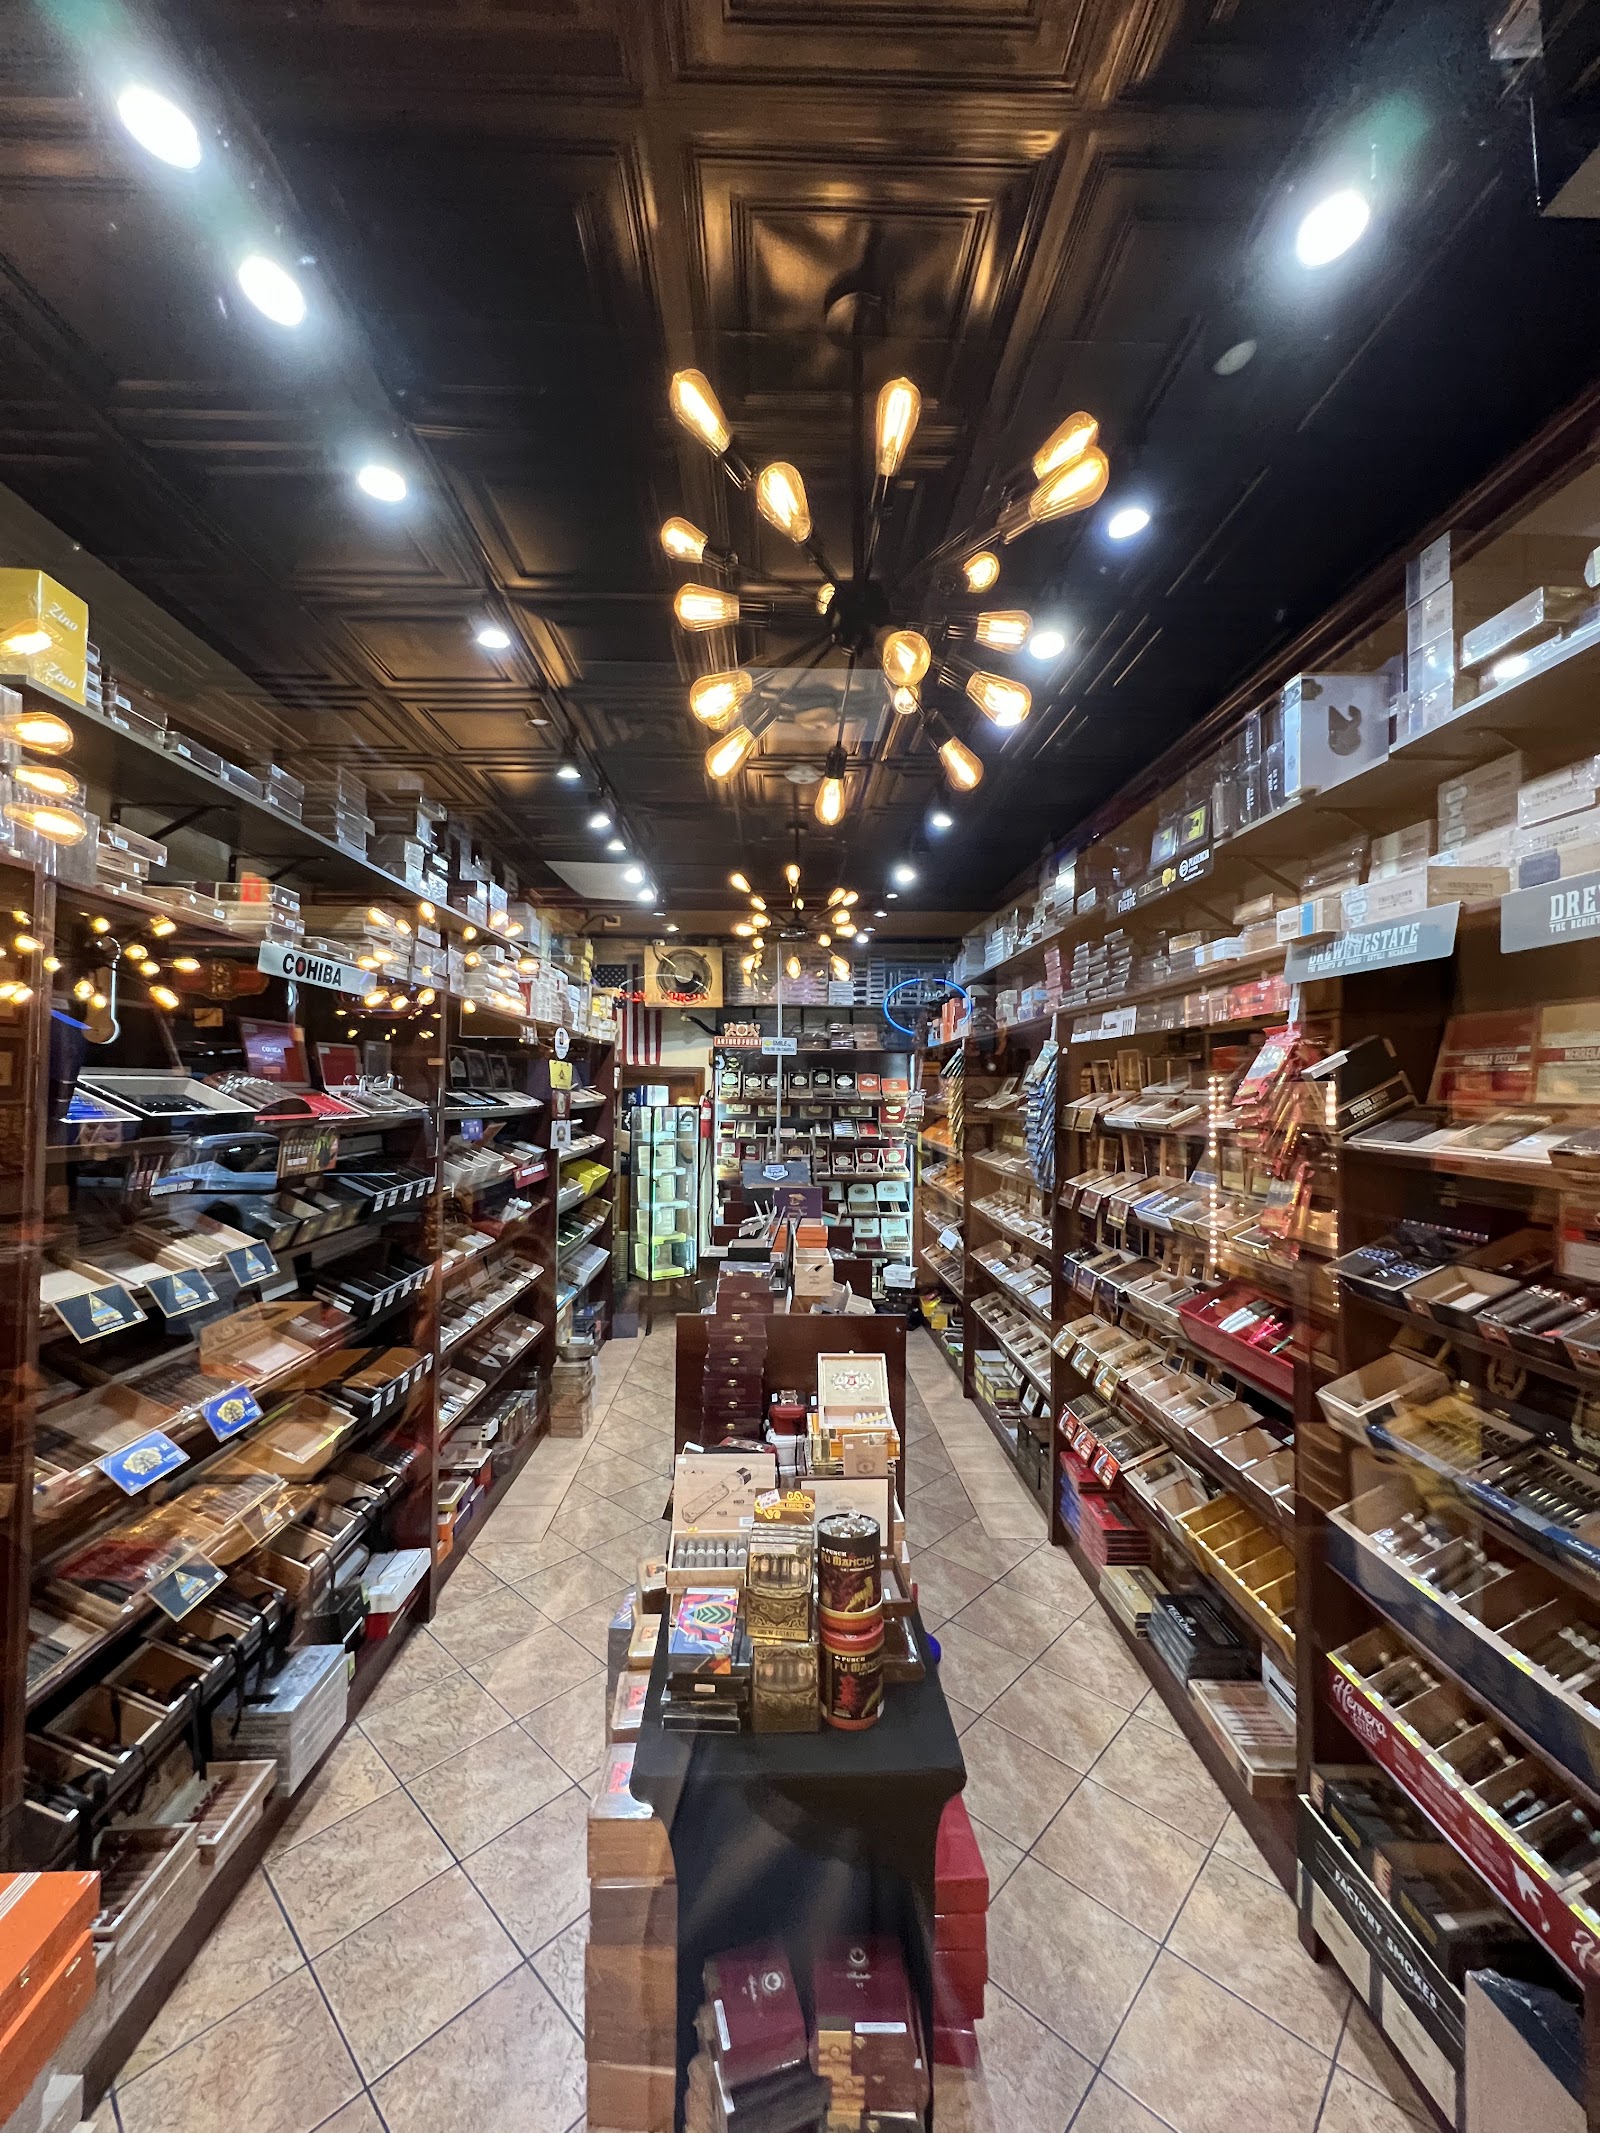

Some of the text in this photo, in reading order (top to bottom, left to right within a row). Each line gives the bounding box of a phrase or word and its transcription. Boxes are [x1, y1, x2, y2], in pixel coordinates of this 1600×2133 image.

[49, 602, 78, 631] Zino
[1550, 884, 1600, 921] DRE
[1363, 922, 1421, 953] ESTATE
[1549, 914, 1600, 933] THE REBIRT
[282, 953, 342, 987] COHIBA
[717, 1038, 762, 1046] ARTURO FUENT
[825, 1548, 847, 1558] PUNCH
[1332, 1674, 1387, 1739] Herrera
[1334, 1869, 1438, 2009] FACTORY SMOKES
